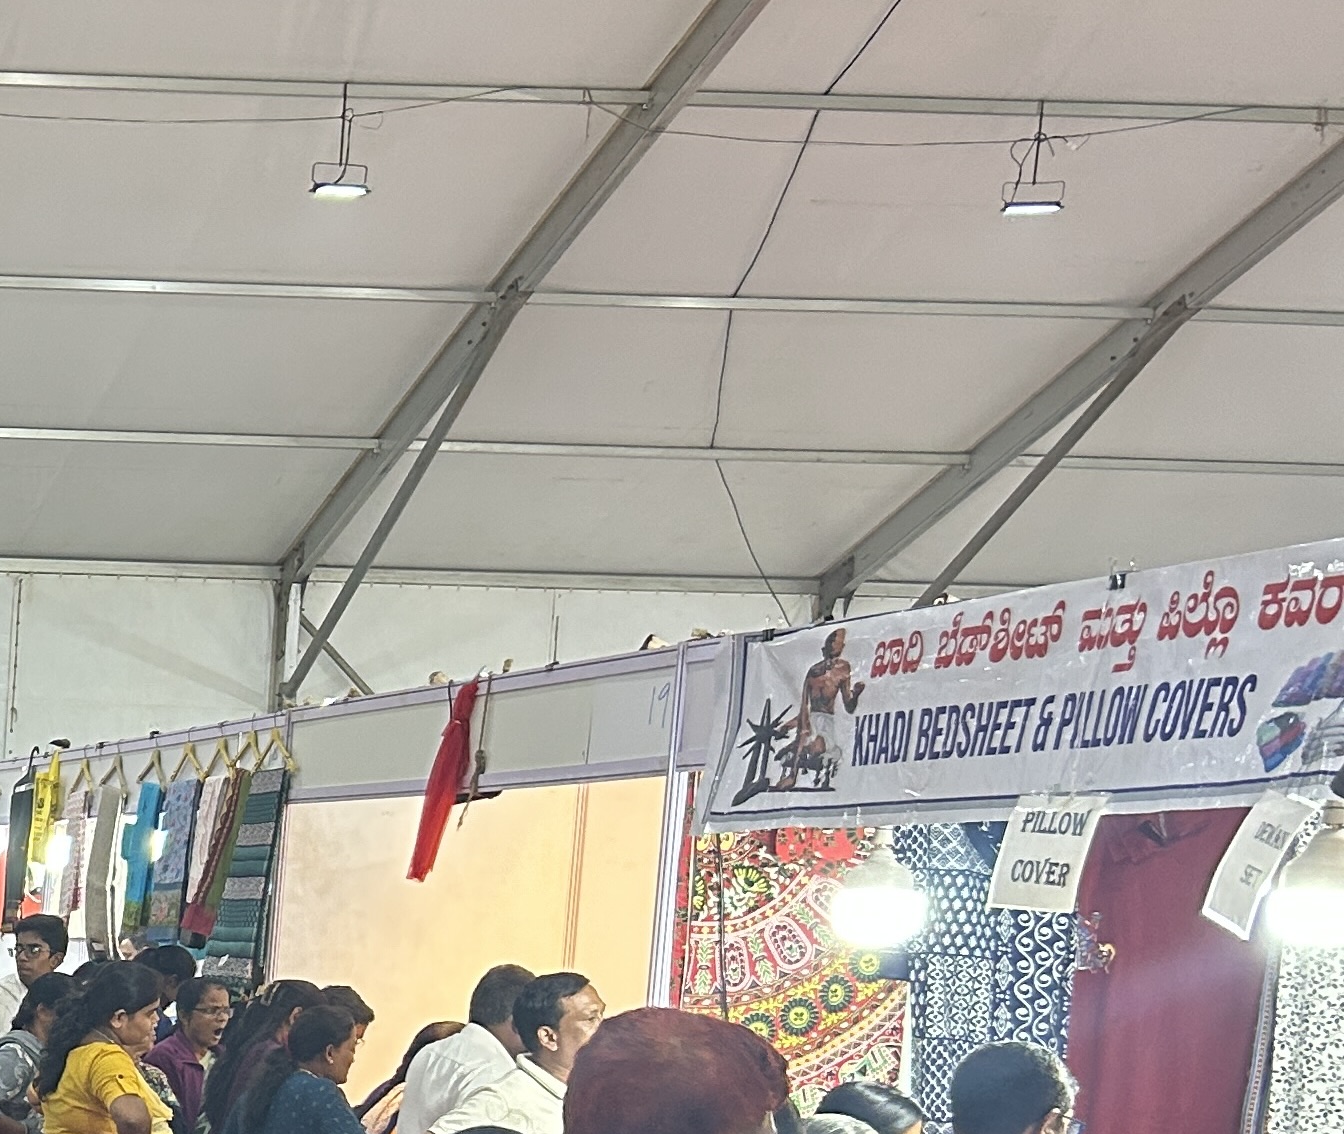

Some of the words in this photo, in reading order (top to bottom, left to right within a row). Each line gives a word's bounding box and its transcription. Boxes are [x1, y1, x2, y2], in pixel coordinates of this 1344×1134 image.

[870, 630, 924, 679] ಖಾದಿ
[1078, 594, 1148, 674] ಮತ್ತು
[850, 709, 914, 768] KHADI
[913, 695, 1038, 762] BEDSHEET
[1031, 693, 1056, 753] &
[1052, 683, 1150, 751] PILLOW
[1143, 674, 1258, 743] COVERS
[1020, 808, 1092, 837] PILLOW
[1010, 858, 1071, 888] COVER
